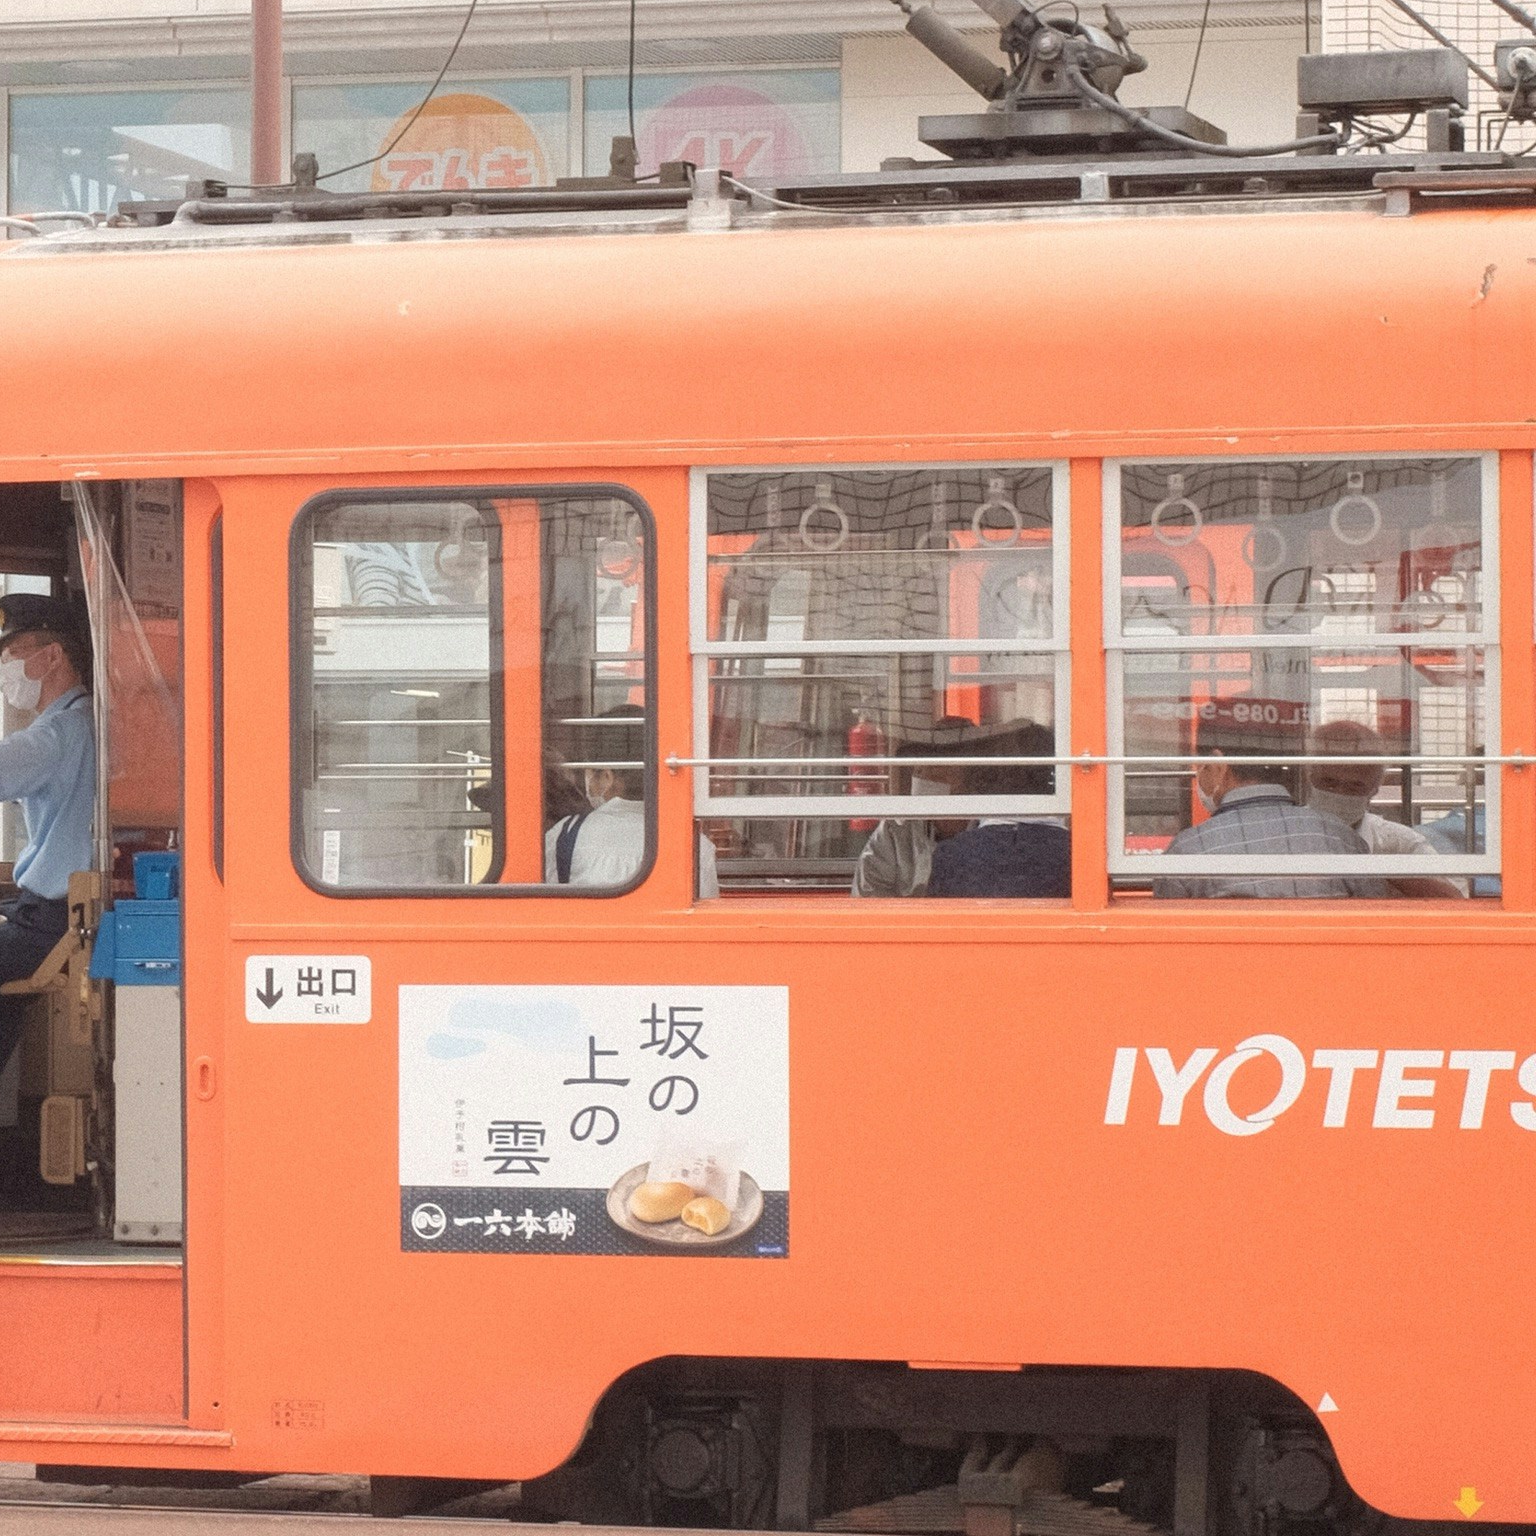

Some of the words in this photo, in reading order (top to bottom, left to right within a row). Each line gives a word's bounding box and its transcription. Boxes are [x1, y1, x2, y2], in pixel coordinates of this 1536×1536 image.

[296, 966, 357, 997] 出口
[314, 1003, 340, 1016] Exit
[640, 1003, 709, 1116] 坂の
[564, 1036, 630, 1146] 上の
[484, 1120, 550, 1175] 雲
[453, 1208, 576, 1241] 一六本舗
